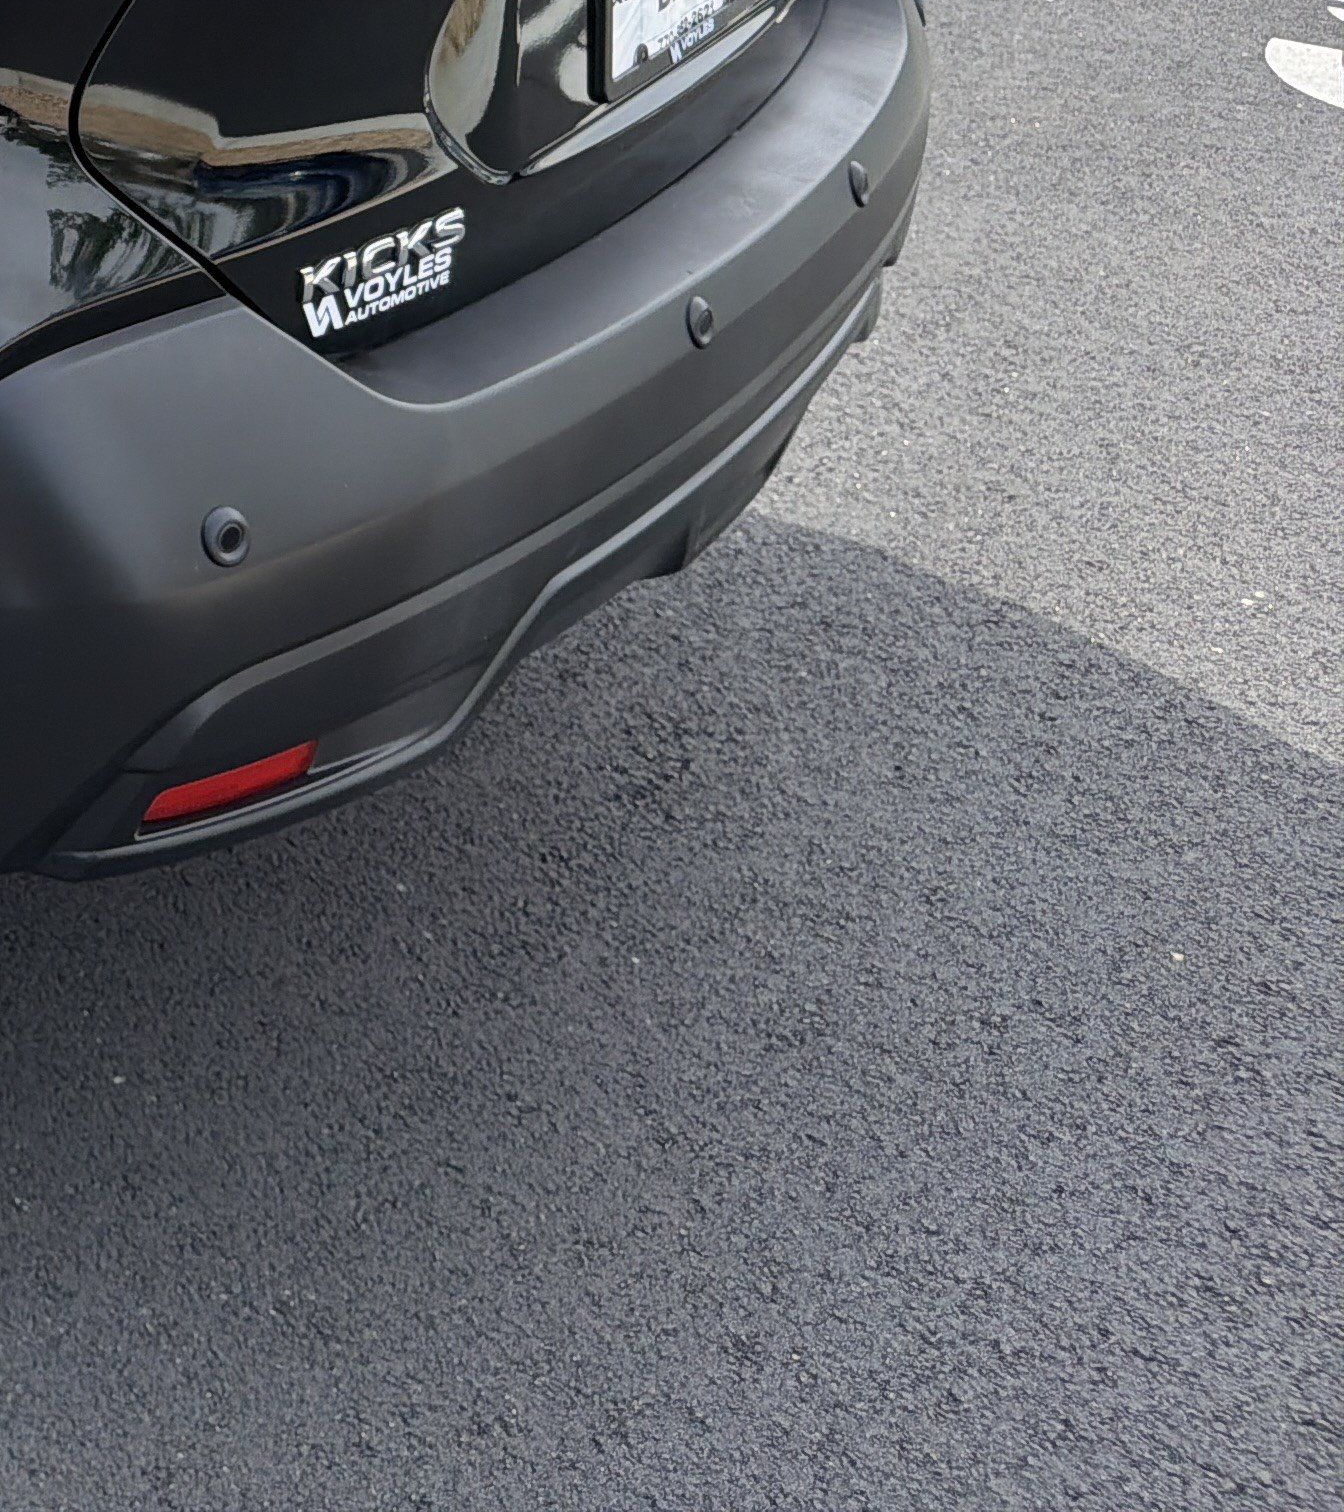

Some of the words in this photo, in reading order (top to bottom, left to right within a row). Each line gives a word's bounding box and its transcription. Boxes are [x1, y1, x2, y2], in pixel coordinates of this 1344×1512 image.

[299, 206, 466, 303] KICKS
[343, 247, 452, 308] VOYLES
[345, 269, 450, 326] AUTOMOTIVE
